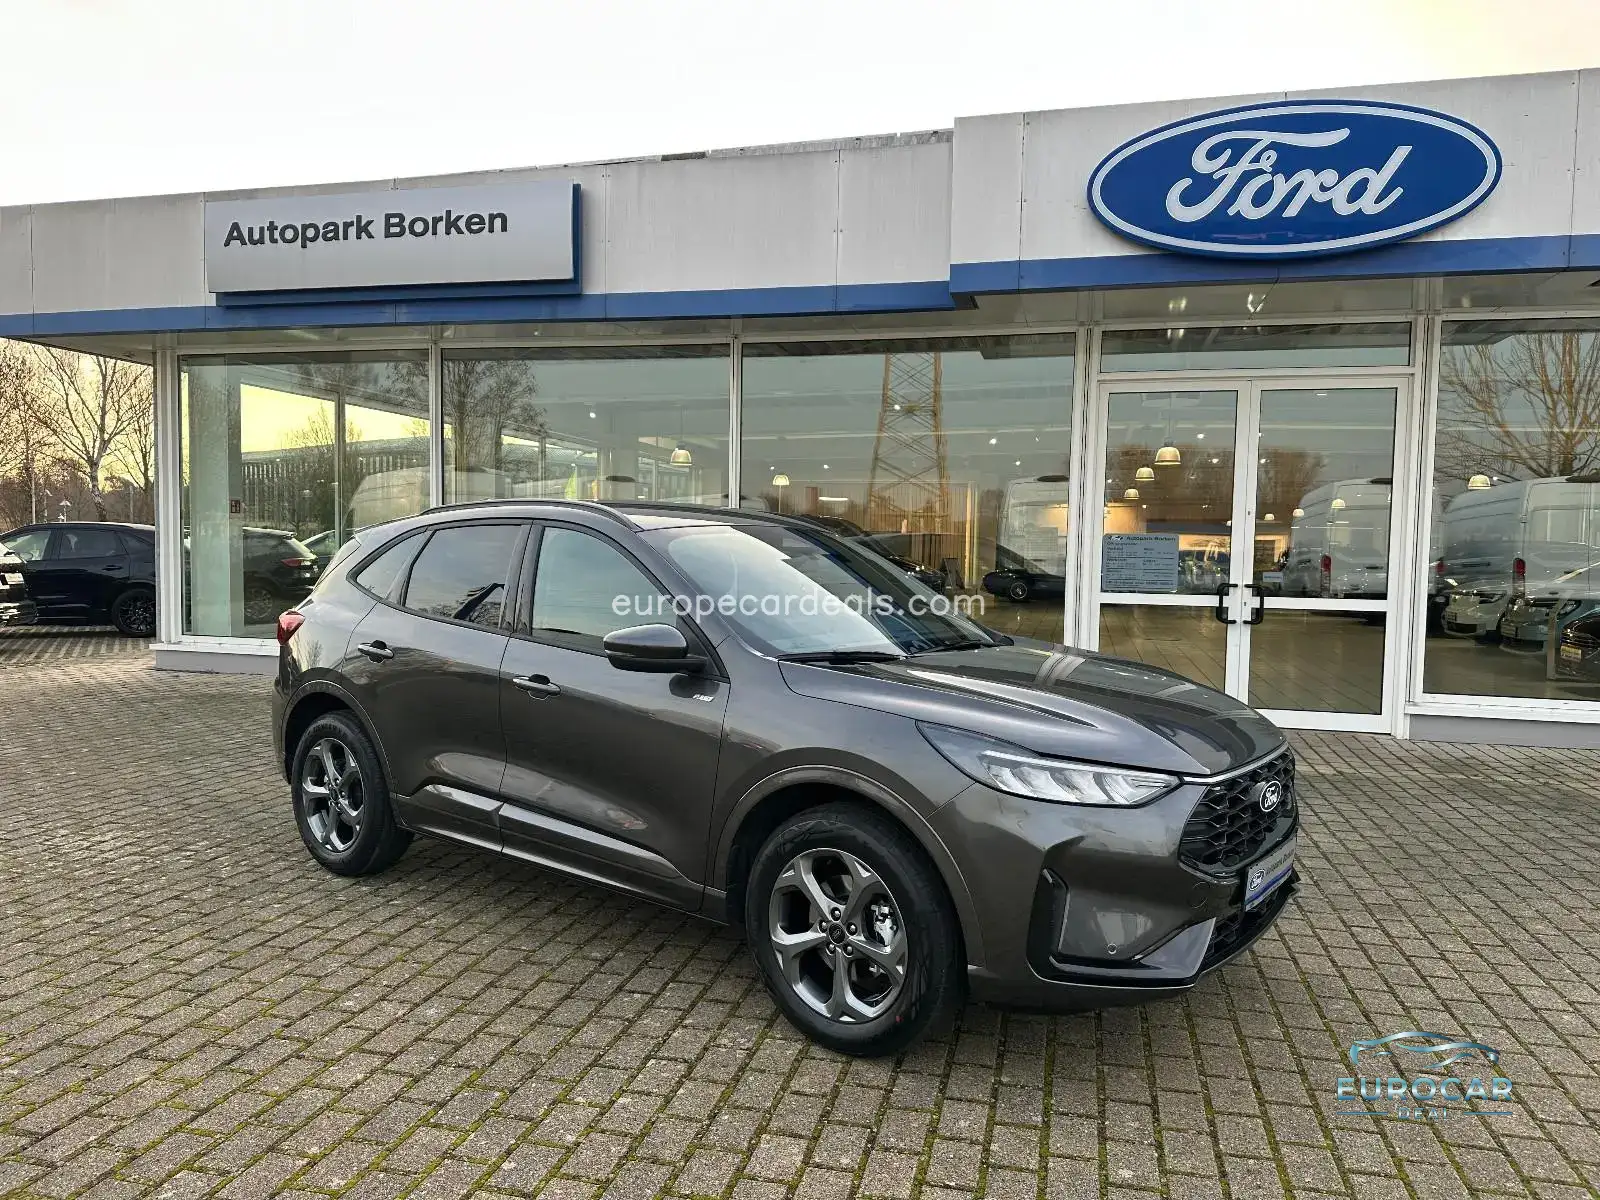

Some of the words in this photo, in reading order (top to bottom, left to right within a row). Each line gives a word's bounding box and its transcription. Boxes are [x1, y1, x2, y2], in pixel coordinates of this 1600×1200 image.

[1165, 127, 1413, 223] Ford
[223, 215, 375, 248] Autopark
[384, 210, 508, 239] Borken
